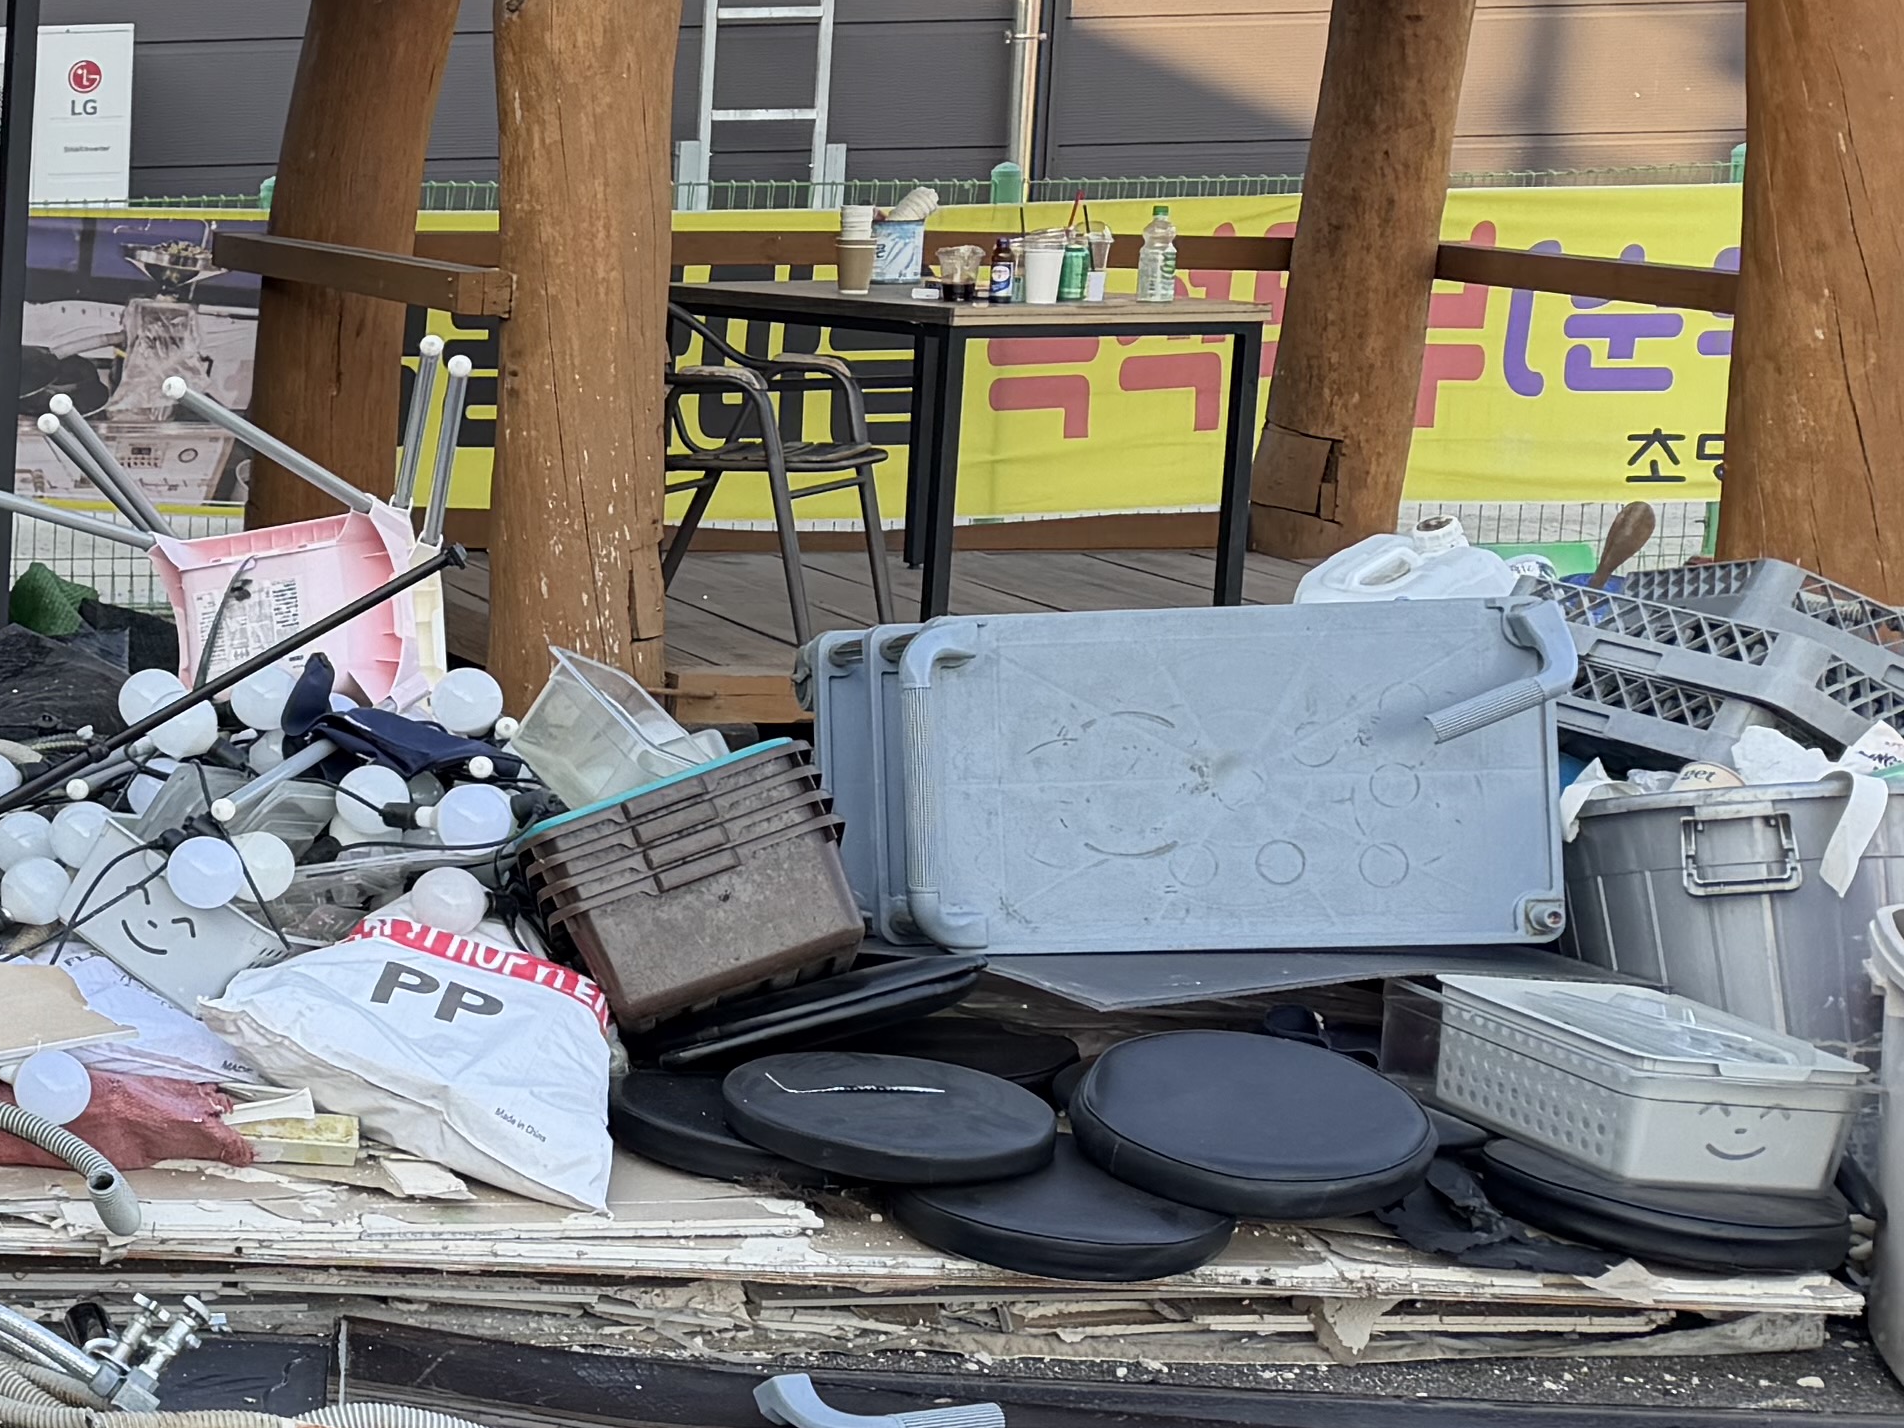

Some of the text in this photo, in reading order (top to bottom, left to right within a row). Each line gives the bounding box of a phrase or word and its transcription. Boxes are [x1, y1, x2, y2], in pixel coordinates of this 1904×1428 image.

[70, 98, 98, 116] LG
[370, 960, 505, 1024] PP
[494, 1107, 547, 1143] Made in China
